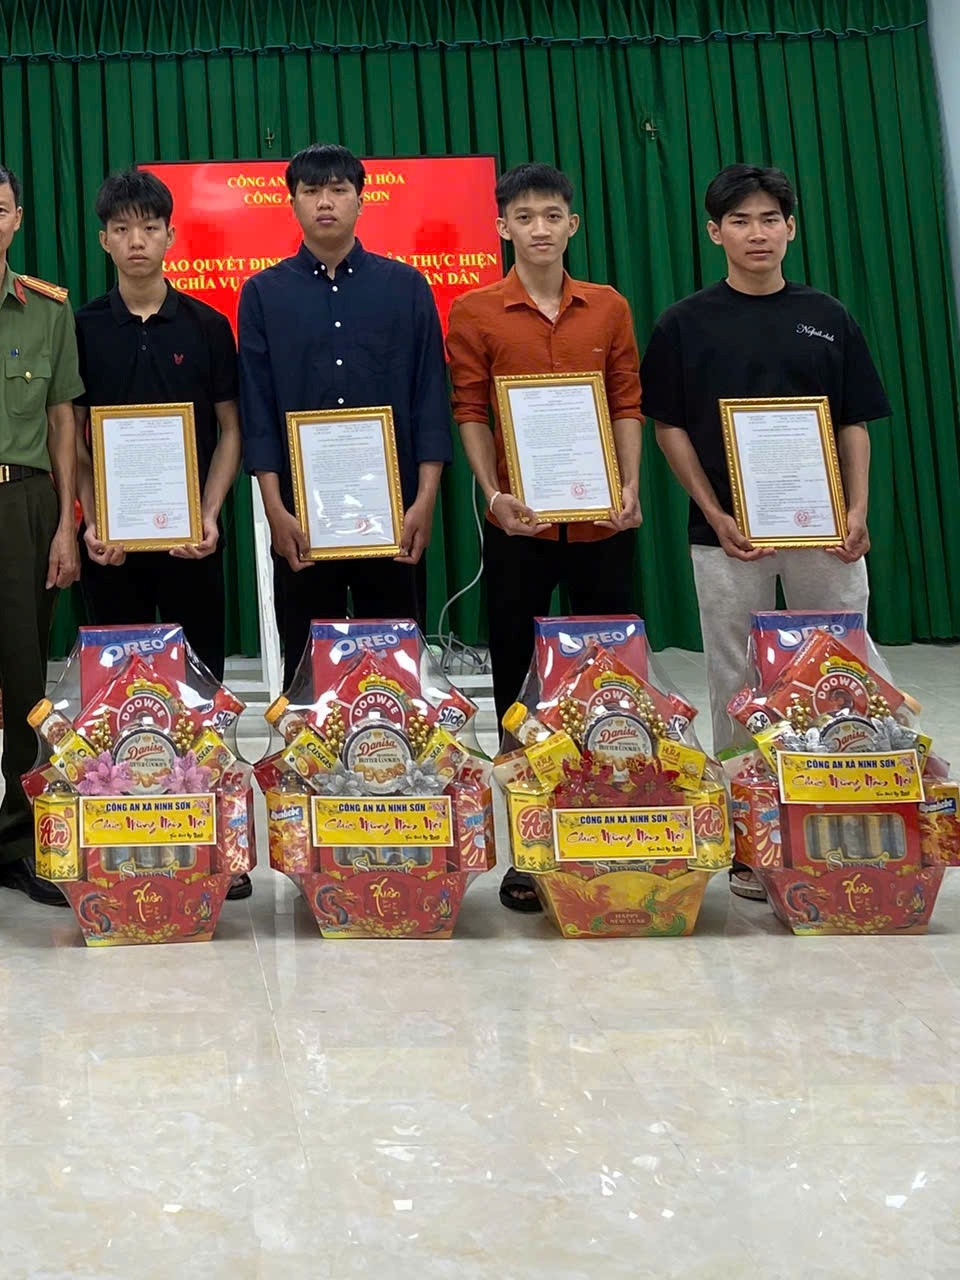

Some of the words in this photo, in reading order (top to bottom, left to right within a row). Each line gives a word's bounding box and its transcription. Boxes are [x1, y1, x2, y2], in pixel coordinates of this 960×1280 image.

[227, 174, 265, 188] CÔNG
[375, 171, 406, 185] HÒA
[243, 190, 282, 205] CÔNG
[363, 190, 390, 201] SƠN
[193, 256, 246, 272] QUYẾT
[409, 252, 455, 270] THỰC
[459, 252, 497, 268] HIỆN
[219, 276, 240, 291] VỤ
[447, 269, 480, 285] DÂN
[102, 638, 165, 662] OREO
[335, 634, 397, 657] OREO
[817, 677, 863, 699] DOOWEE
[121, 698, 166, 721] DOOWEE
[354, 693, 399, 717] DOOWEE
[215, 710, 237, 728] Slid
[439, 707, 464, 727] Slide
[598, 726, 638, 744] Danisa
[126, 742, 164, 760] Danisa
[306, 742, 333, 768] Custas
[357, 738, 397, 756] Danisa
[429, 742, 445, 761] stas
[661, 746, 681, 759] HURA
[806, 758, 830, 768] CÔNG
[832, 760, 843, 768] AN
[858, 760, 877, 768] NINH
[880, 758, 896, 768] SƠN
[220, 772, 243, 786] FC
[459, 767, 483, 783] FC
[106, 802, 127, 812] CÔNG
[130, 802, 140, 812] AN
[154, 802, 174, 811] NINH
[175, 800, 191, 810] SƠN
[339, 802, 360, 812] CÔNG
[363, 803, 374, 812] AN
[388, 804, 408, 812] NINH
[410, 802, 426, 812] SƠN
[580, 814, 602, 824] CÔNG
[604, 815, 615, 824] AN
[630, 814, 650, 824] NINH
[652, 814, 668, 823] SƠN
[40, 816, 67, 846] An
